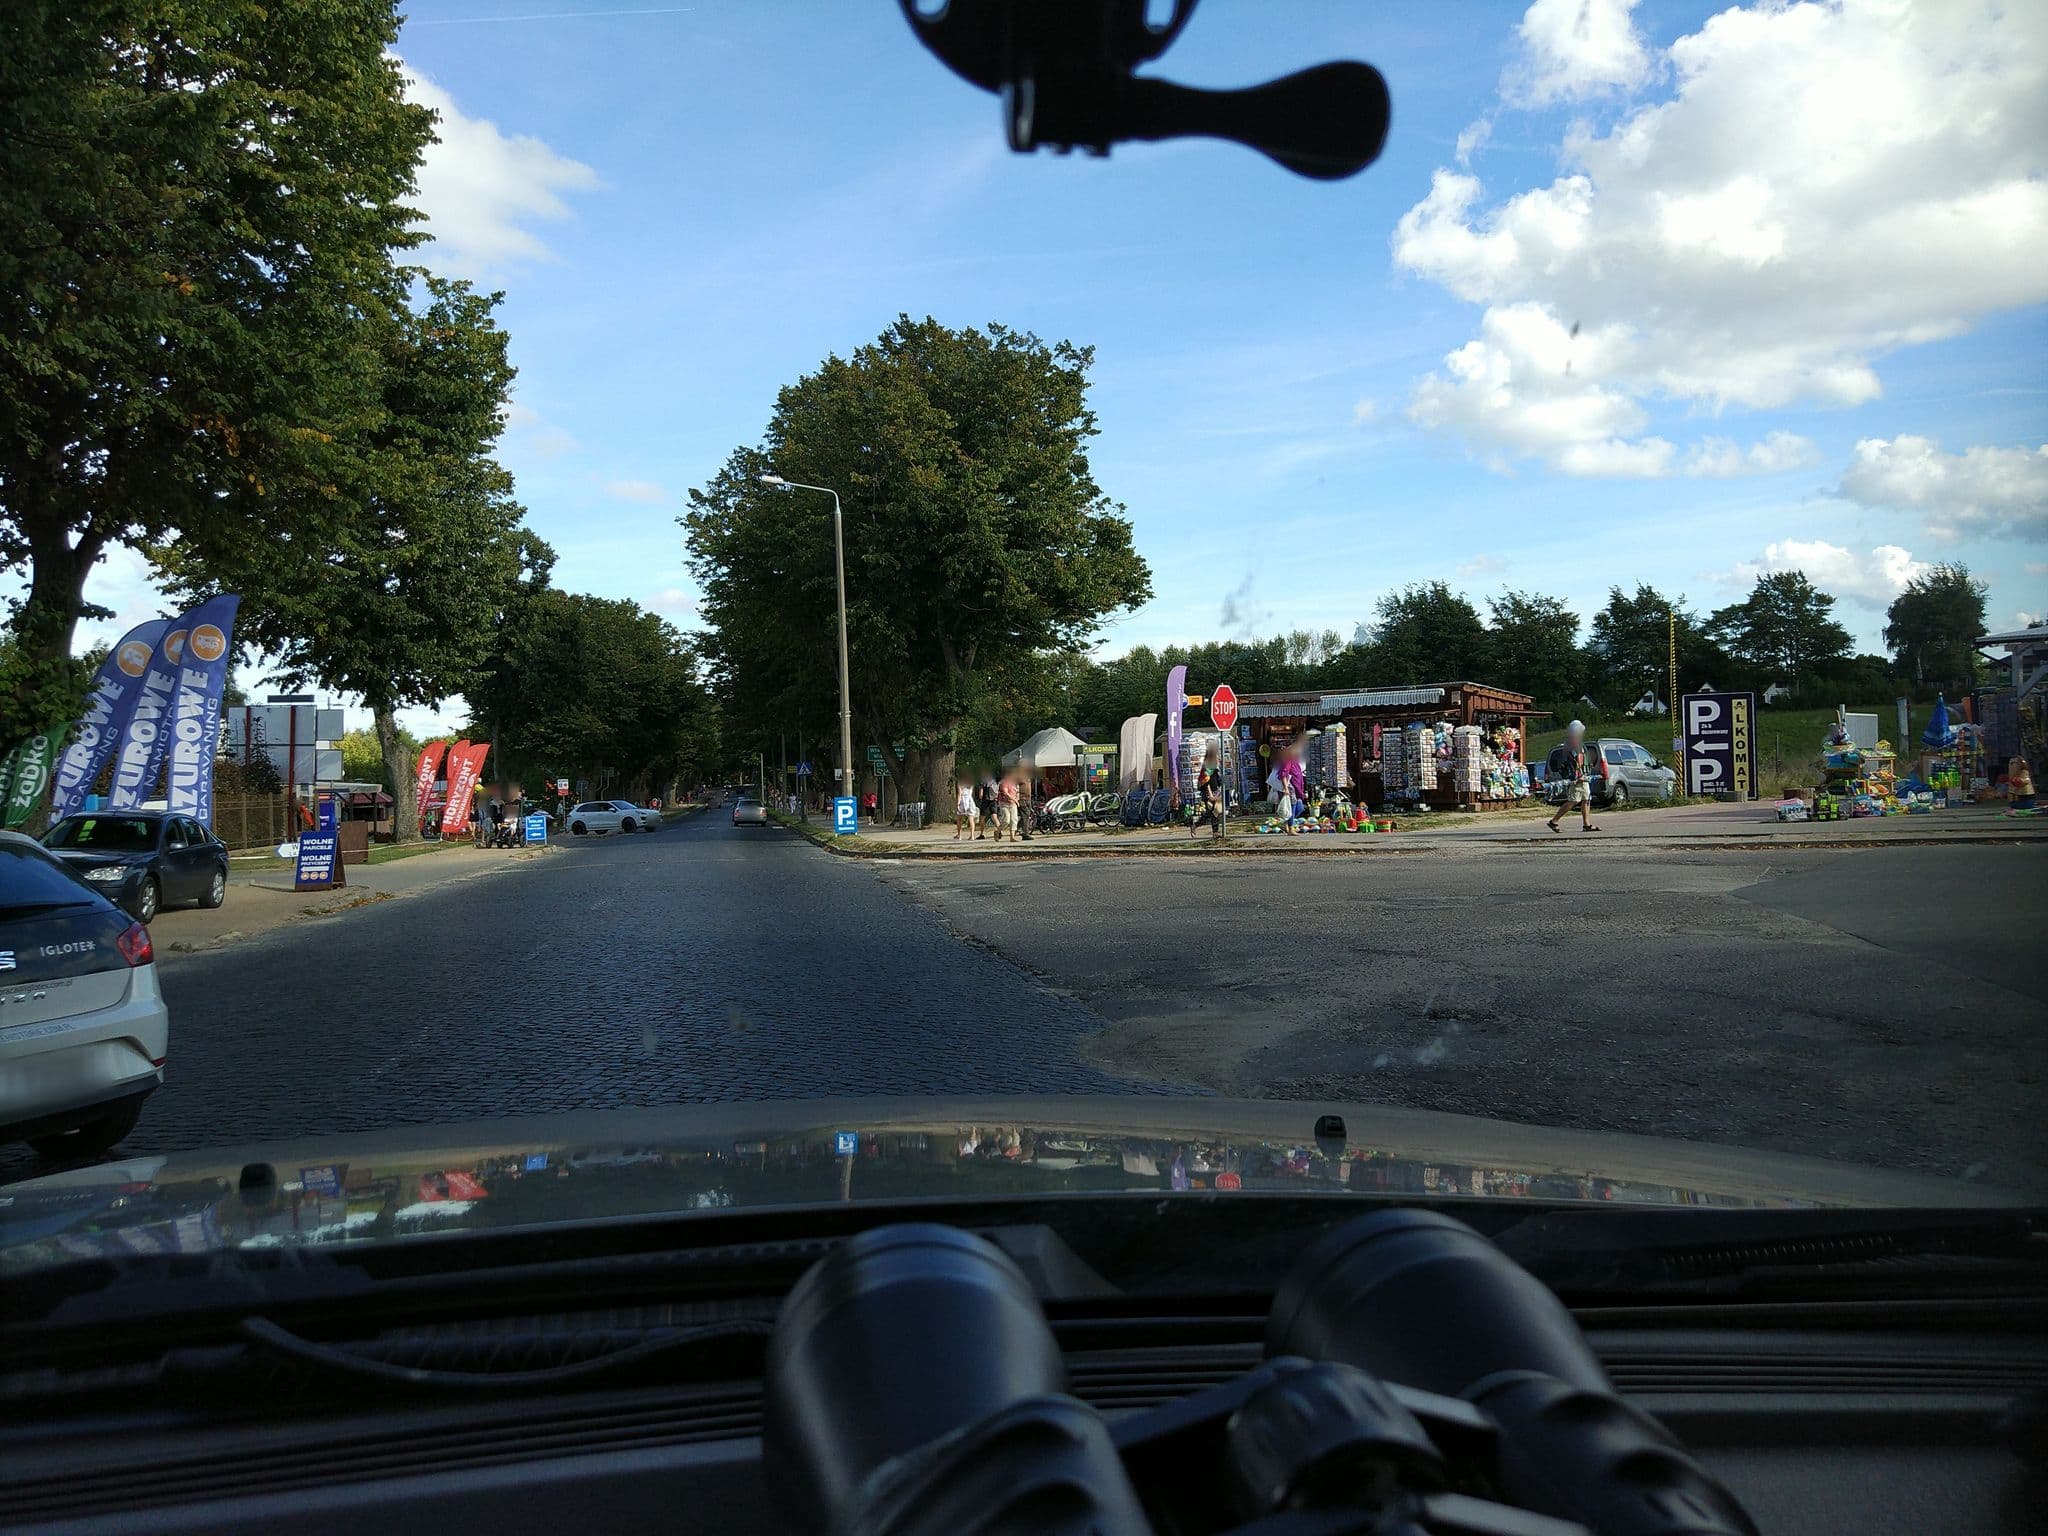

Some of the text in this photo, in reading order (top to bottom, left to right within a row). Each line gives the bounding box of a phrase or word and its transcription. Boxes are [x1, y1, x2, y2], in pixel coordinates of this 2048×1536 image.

[1214, 701, 1235, 715] STOP
[1689, 700, 1721, 736] P
[198, 697, 219, 820] CARAVANING
[1735, 701, 1747, 789] ALKOMAT
[69, 726, 119, 807] CAMPING
[1691, 758, 1723, 793] P
[443, 758, 474, 825] HORYZONT
[837, 805, 853, 826] P
[40, 940, 97, 957] IGLOTEX
